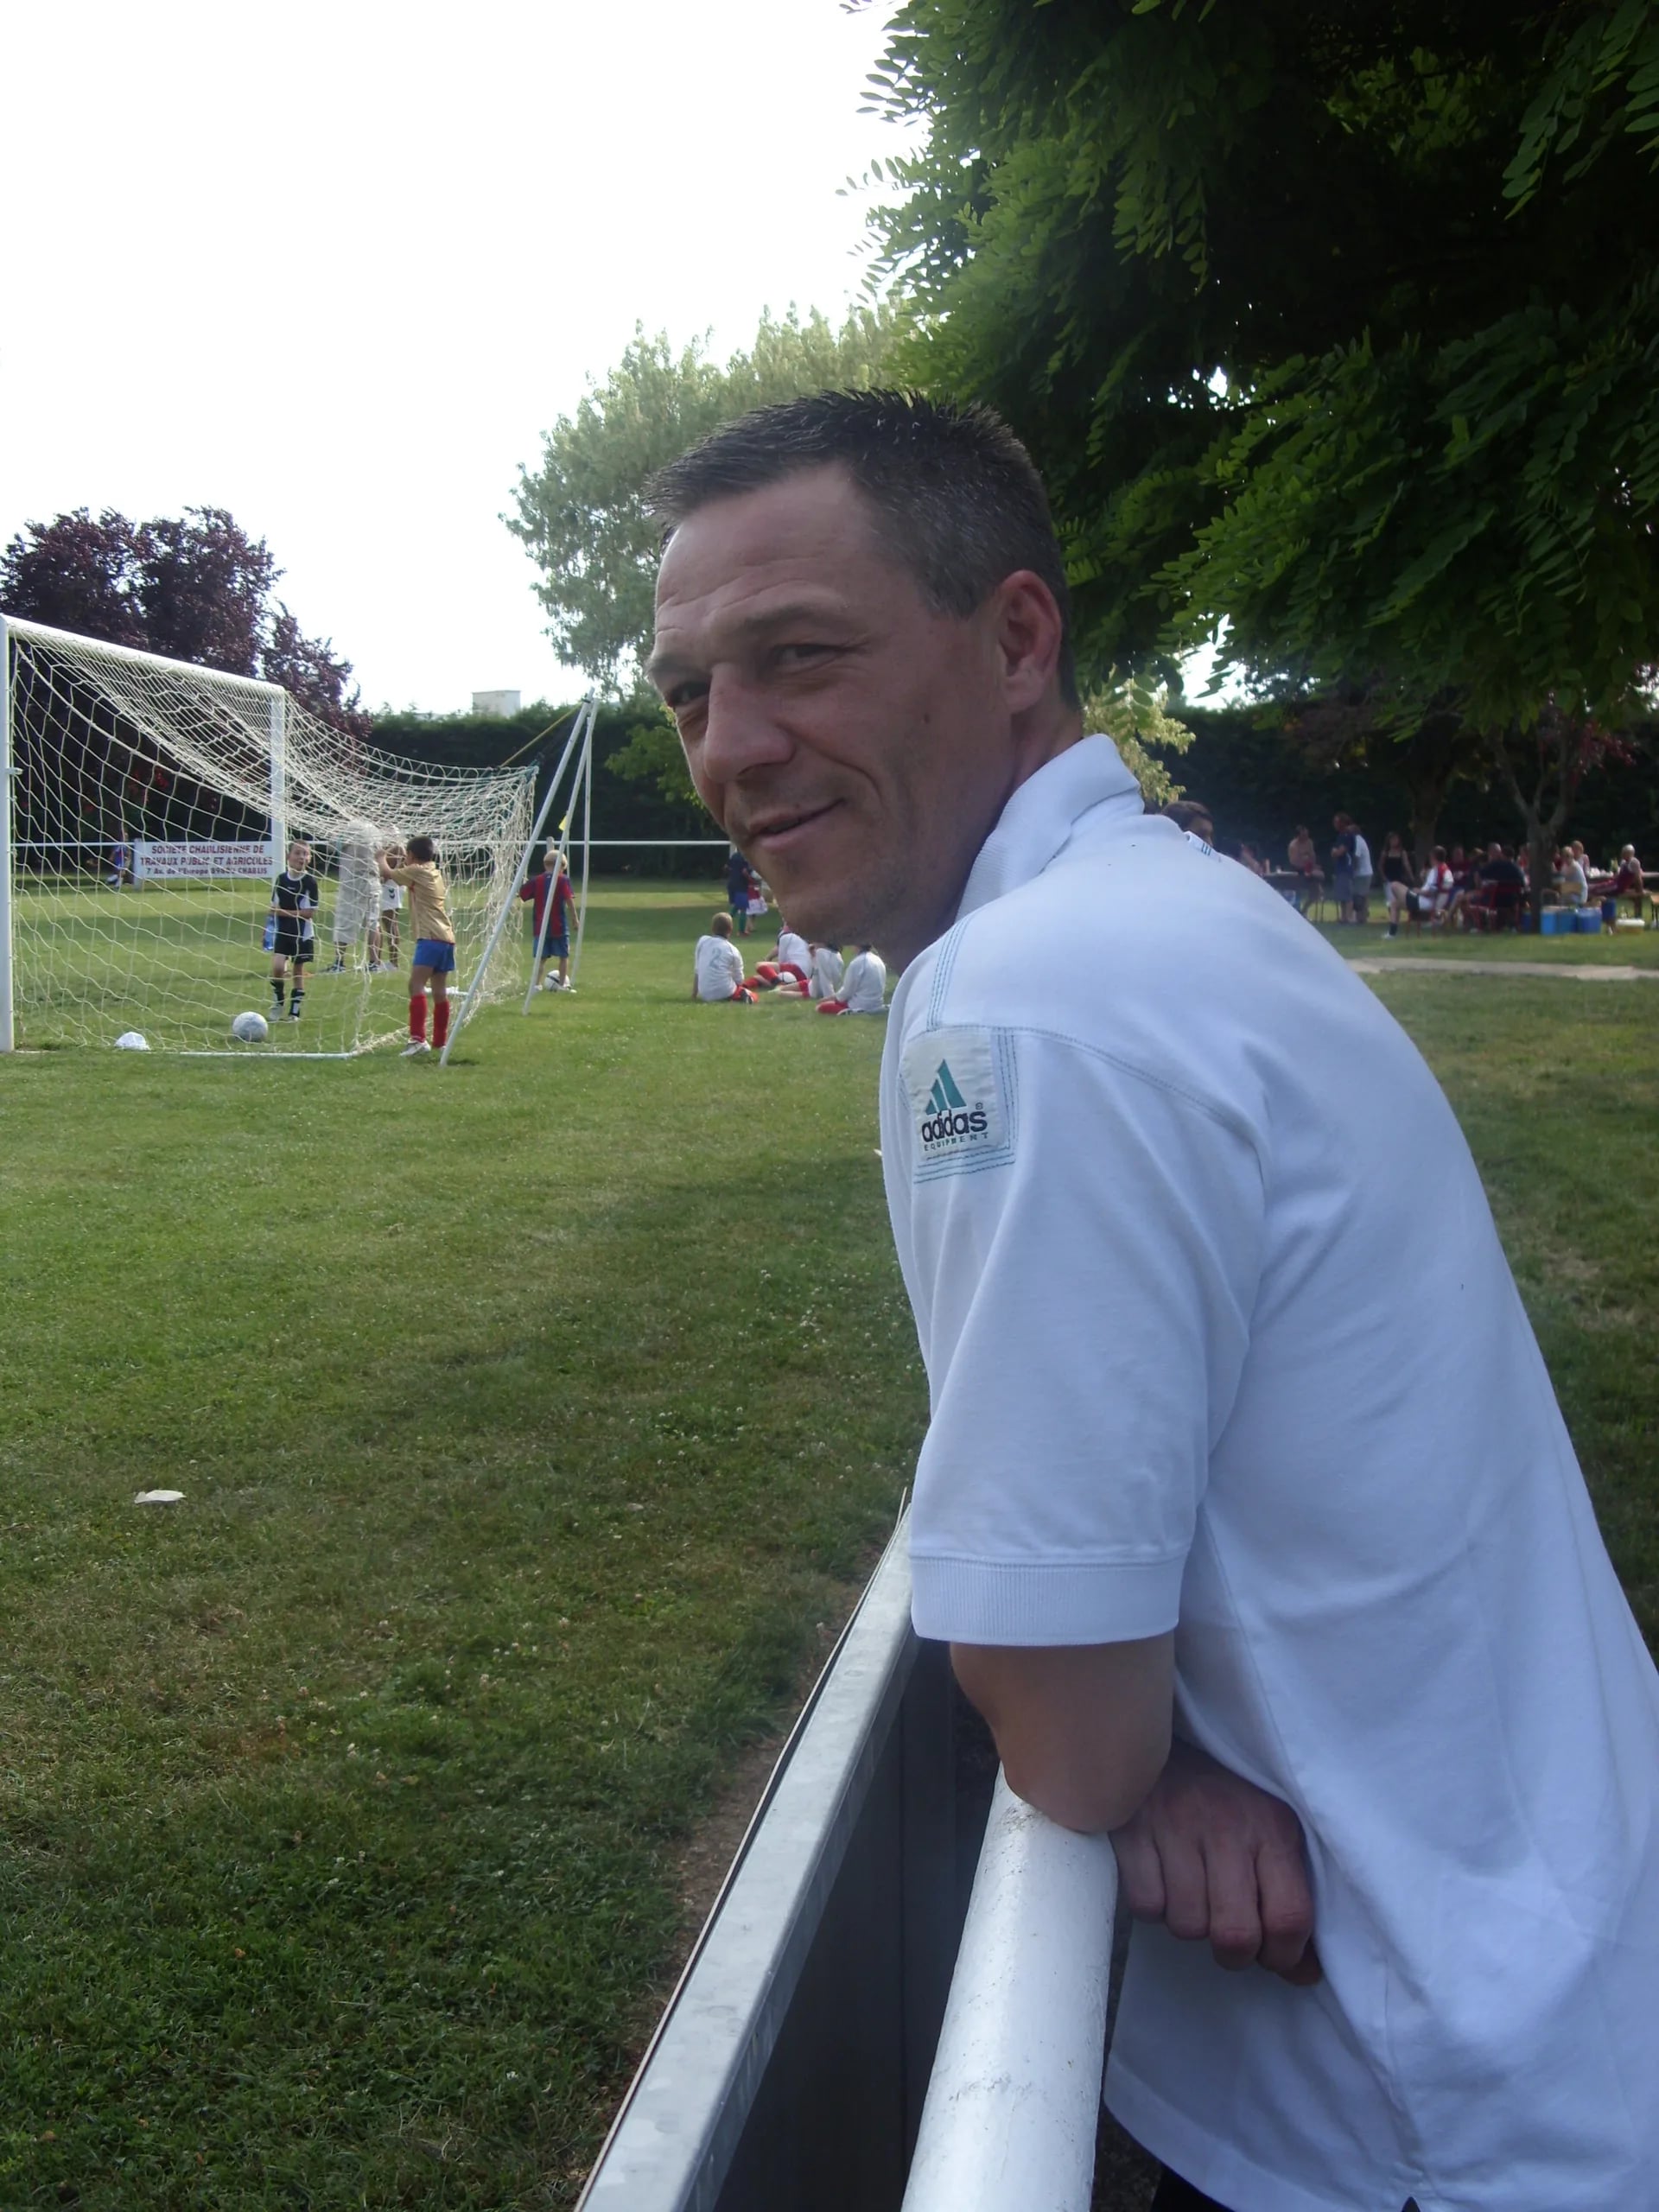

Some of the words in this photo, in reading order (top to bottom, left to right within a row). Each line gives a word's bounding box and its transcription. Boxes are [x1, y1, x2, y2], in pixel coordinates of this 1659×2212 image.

[253, 845, 264, 854] DE
[922, 1109, 988, 1142] adidas
[924, 1131, 988, 1151] EQUIPMENT
